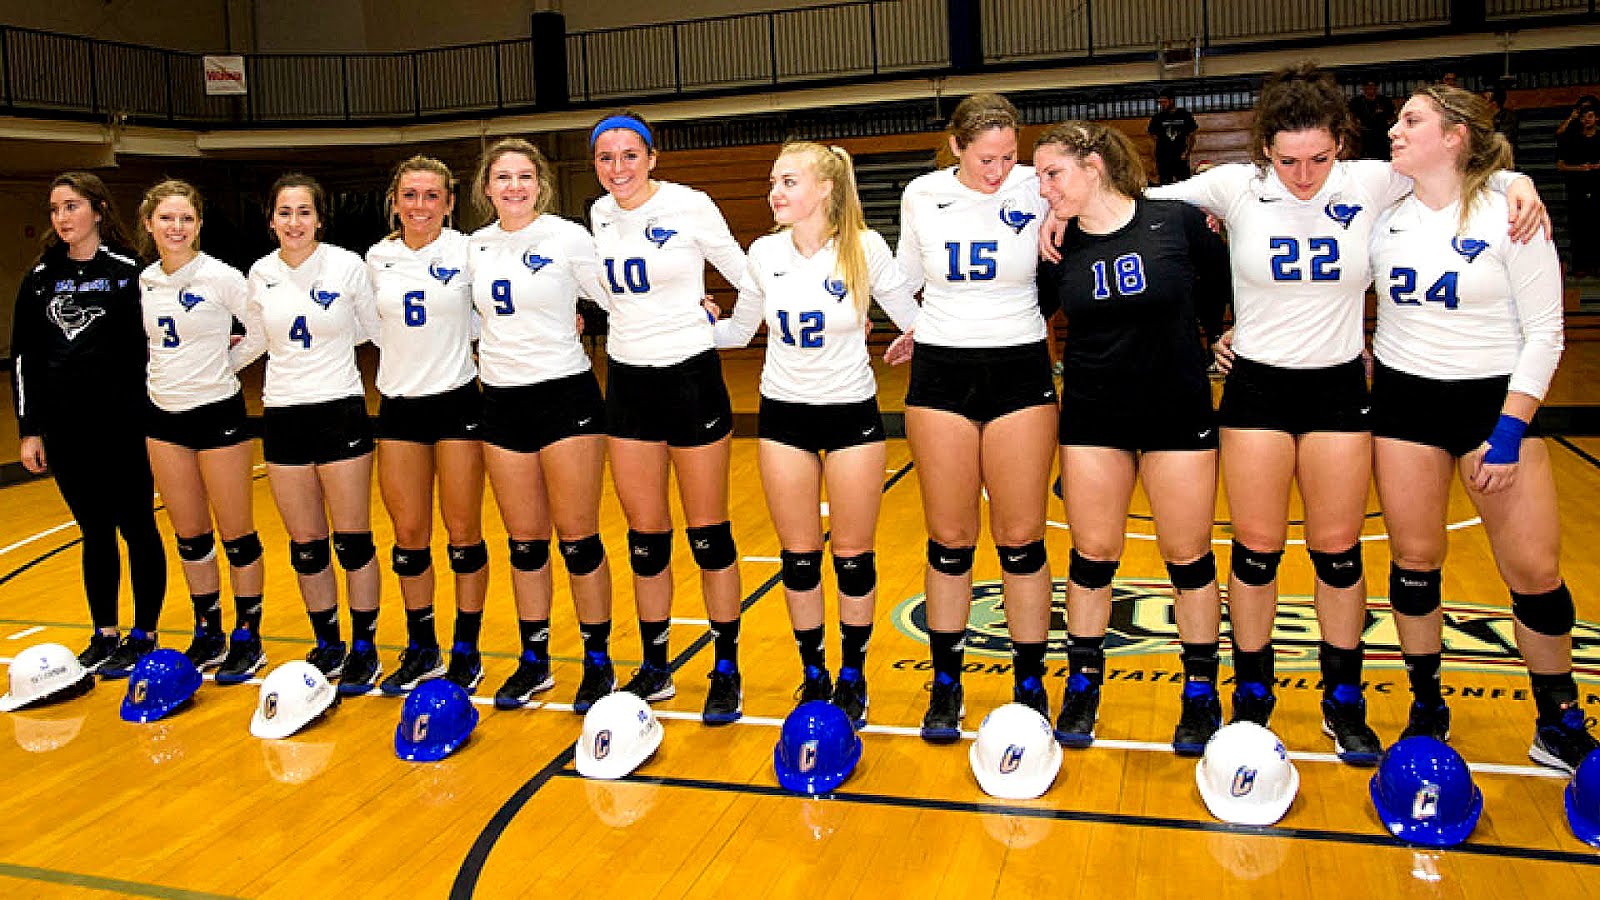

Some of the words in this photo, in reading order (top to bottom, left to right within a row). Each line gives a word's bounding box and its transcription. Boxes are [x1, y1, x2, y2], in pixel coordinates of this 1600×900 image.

[604, 257, 651, 294] 10
[945, 241, 999, 282] 15
[1091, 252, 1147, 299] 18
[1269, 236, 1341, 281] 22
[491, 279, 516, 316] 9
[1389, 267, 1460, 310] 24
[404, 290, 427, 327] 6
[157, 316, 180, 348] 3
[289, 315, 311, 349] 4
[776, 310, 824, 348] 12
